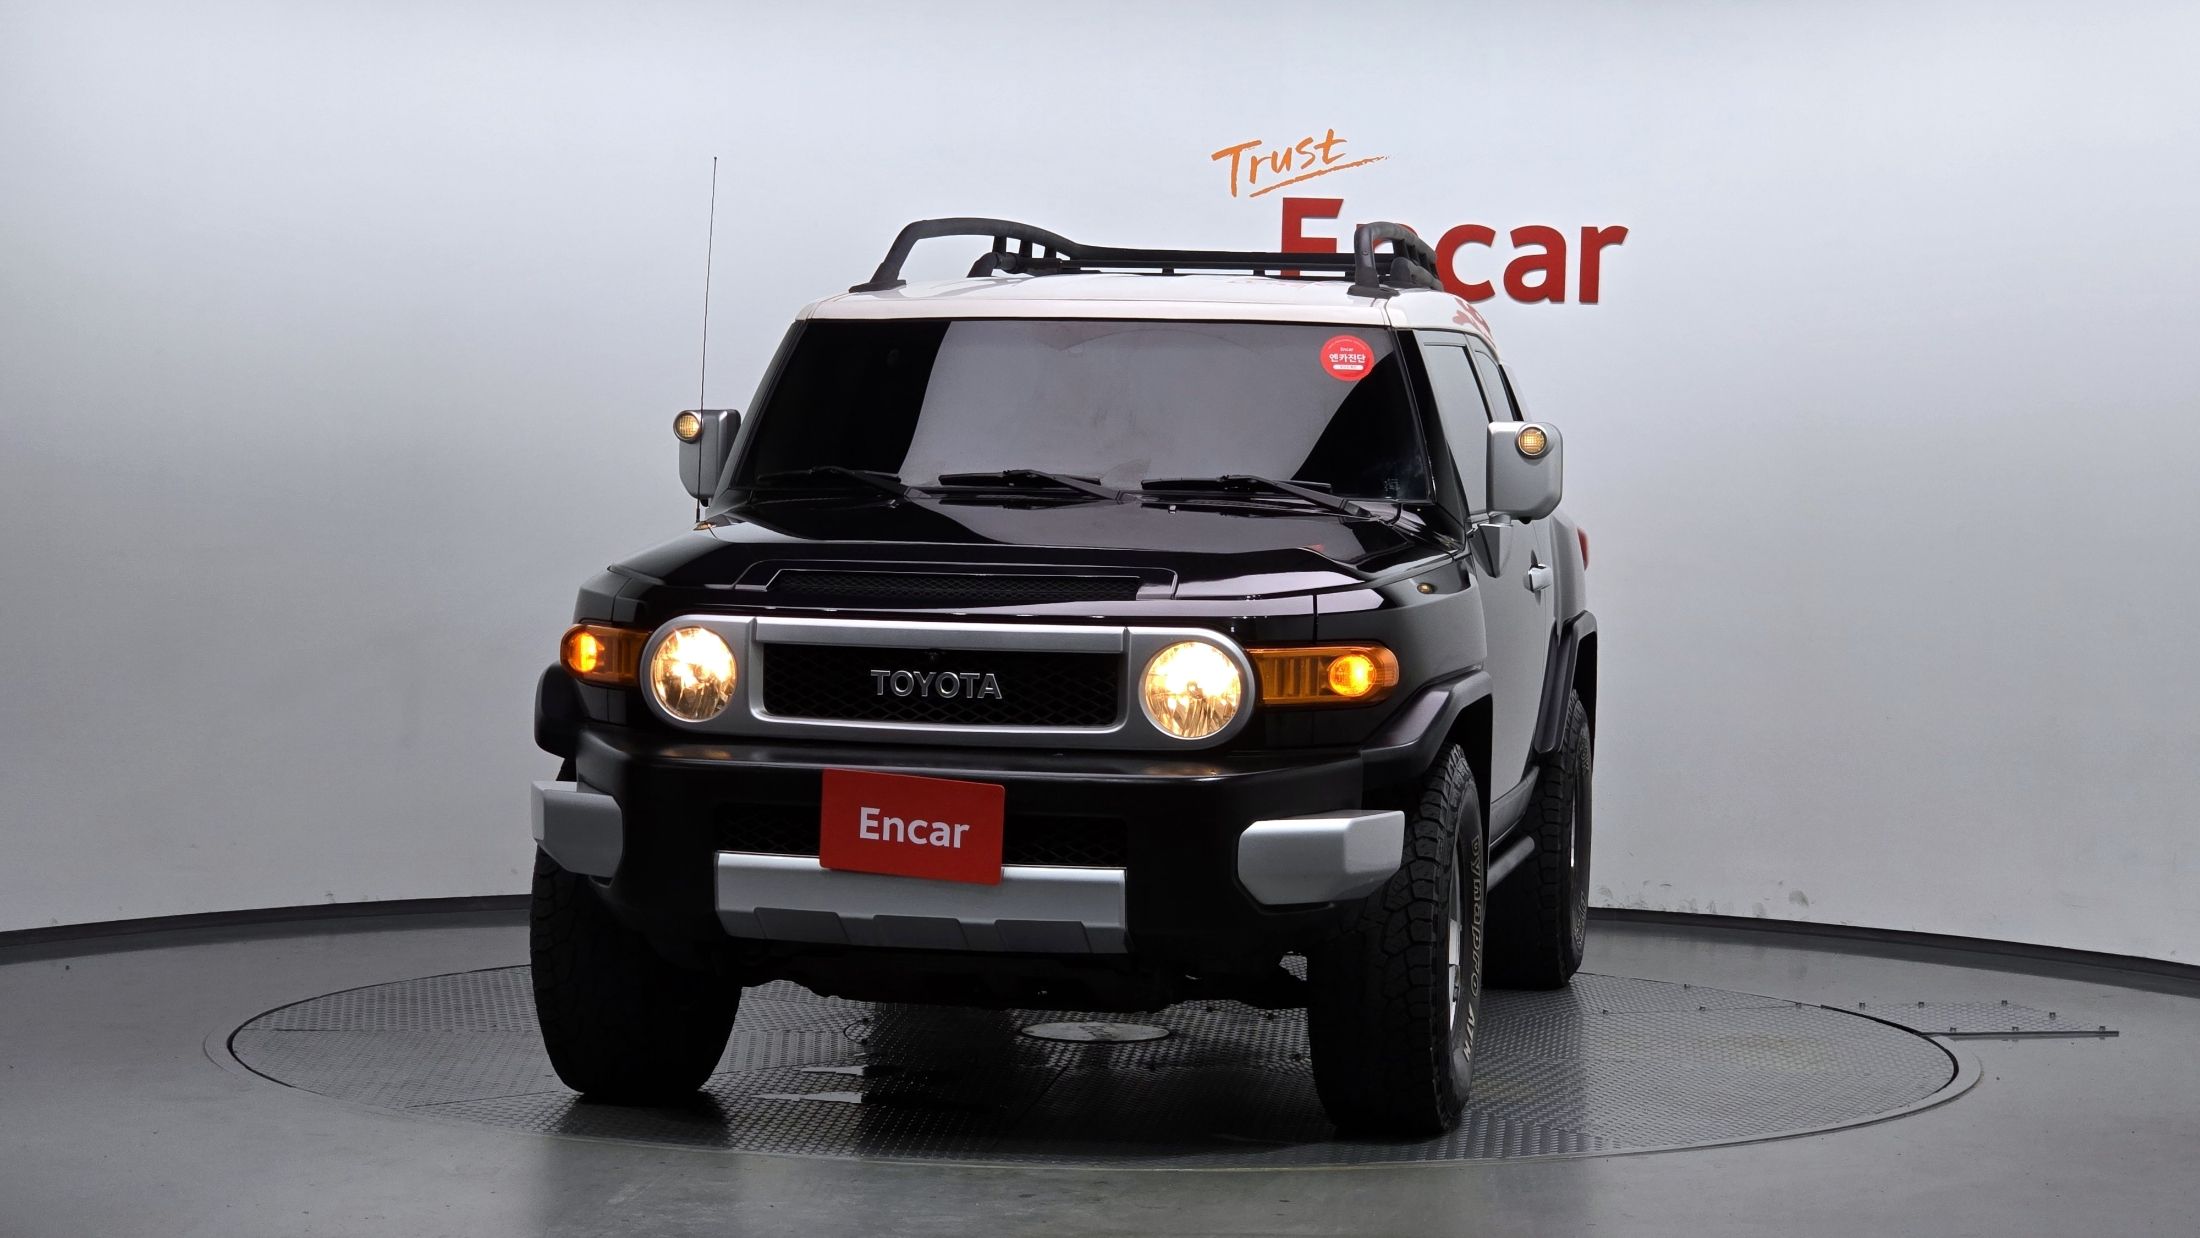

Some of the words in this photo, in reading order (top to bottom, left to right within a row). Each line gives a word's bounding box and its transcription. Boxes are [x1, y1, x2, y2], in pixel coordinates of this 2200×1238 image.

[1211, 128, 1348, 197] Trust
[1280, 197, 1629, 305] Ecar
[1328, 353, 1366, 363] 엔카진단
[870, 669, 1003, 699] TOYOTA
[859, 806, 970, 849] Encar
